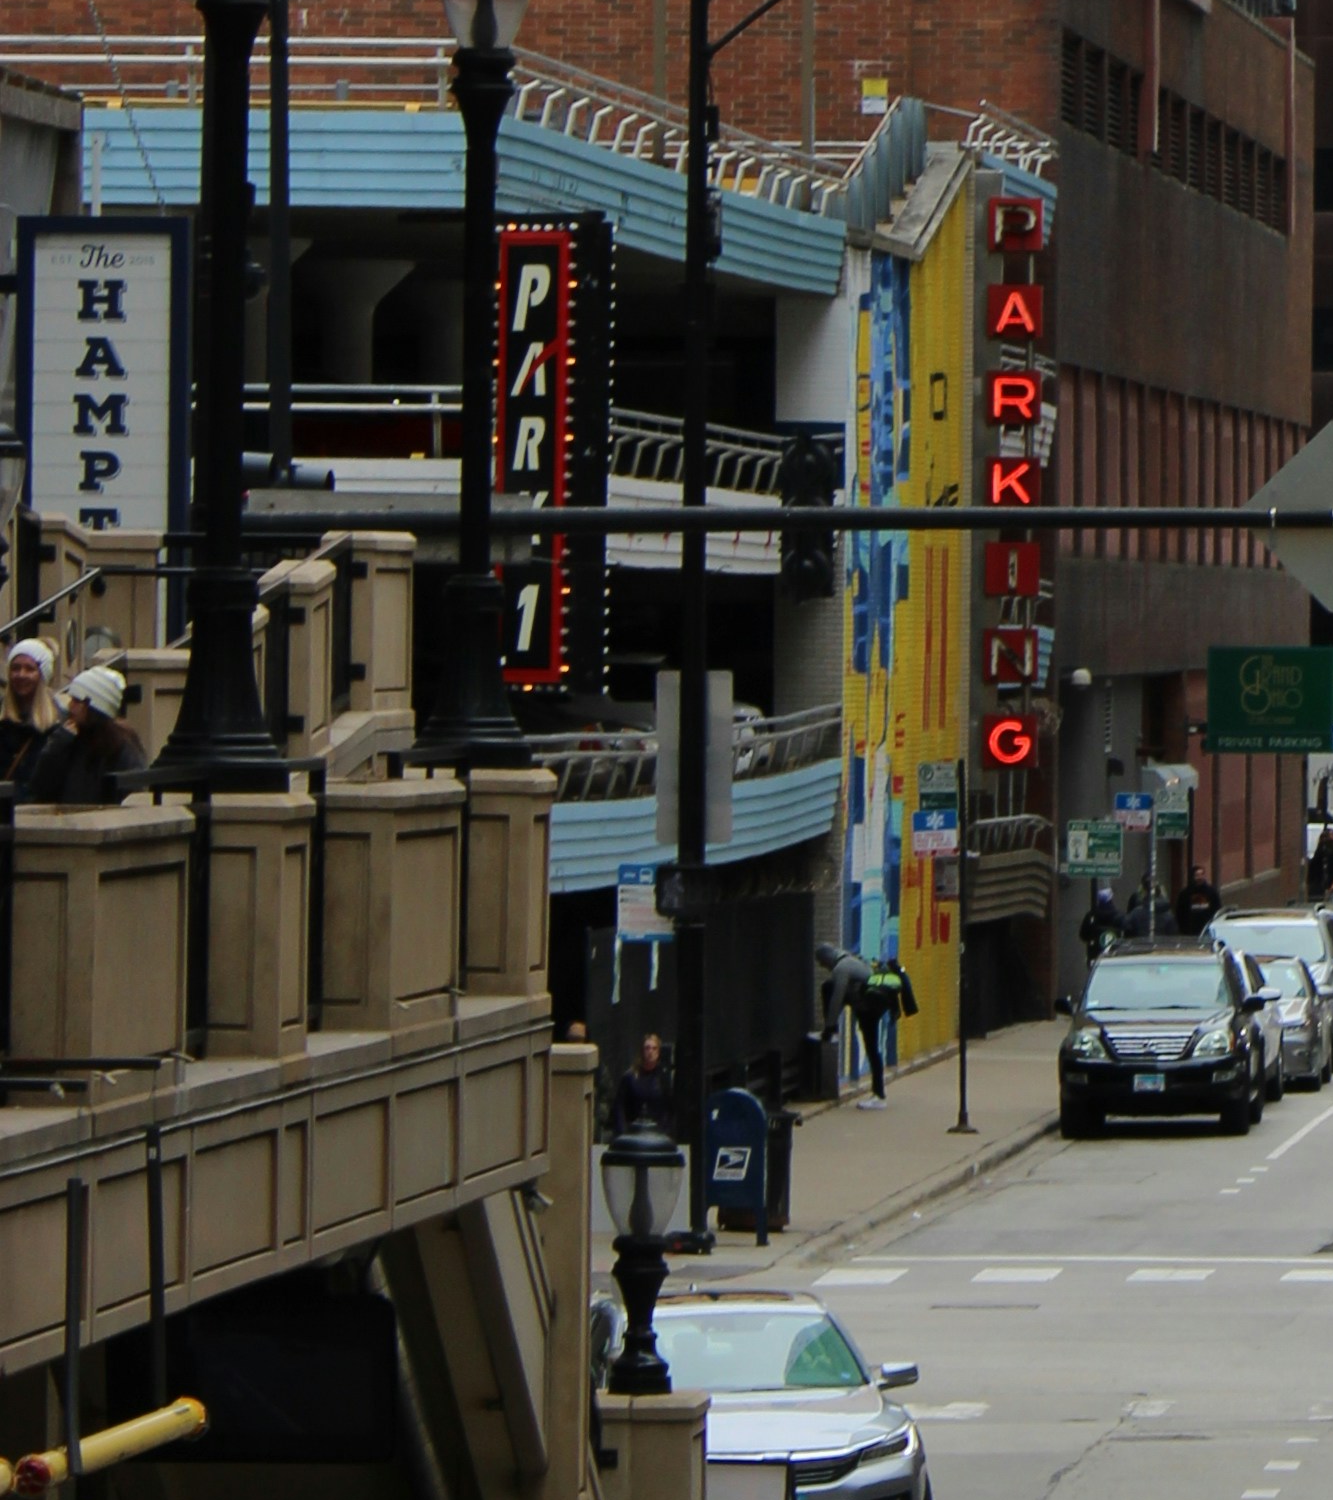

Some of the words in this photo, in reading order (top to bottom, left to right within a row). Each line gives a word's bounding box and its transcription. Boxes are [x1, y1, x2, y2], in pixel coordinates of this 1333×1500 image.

[80, 244, 126, 269] The
[988, 203, 1037, 764] PARKING
[516, 584, 541, 652] 1
[1218, 736, 1263, 748] PRIVATE
[1268, 736, 1322, 748] PARKING
